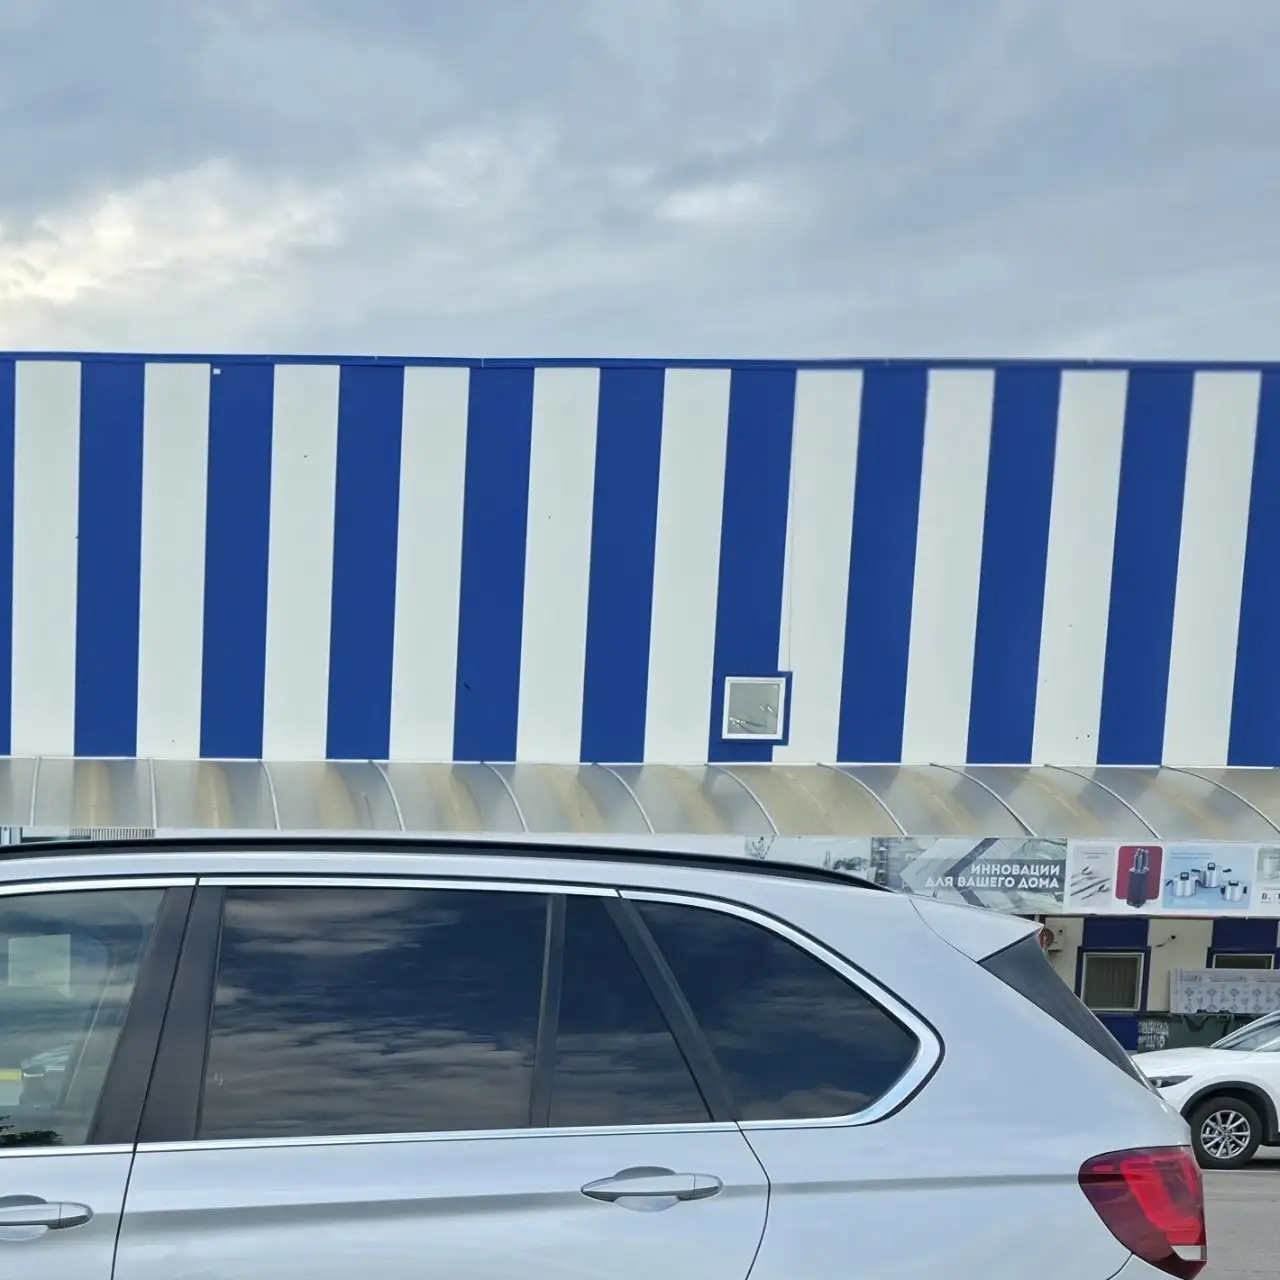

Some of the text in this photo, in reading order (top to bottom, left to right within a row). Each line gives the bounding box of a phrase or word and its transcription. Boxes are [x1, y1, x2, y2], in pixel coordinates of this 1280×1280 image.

[971, 863, 1060, 876] ИННОВАЦИИ
[924, 876, 1060, 889] ДЛЯ ВАШЕГО ДОМА
